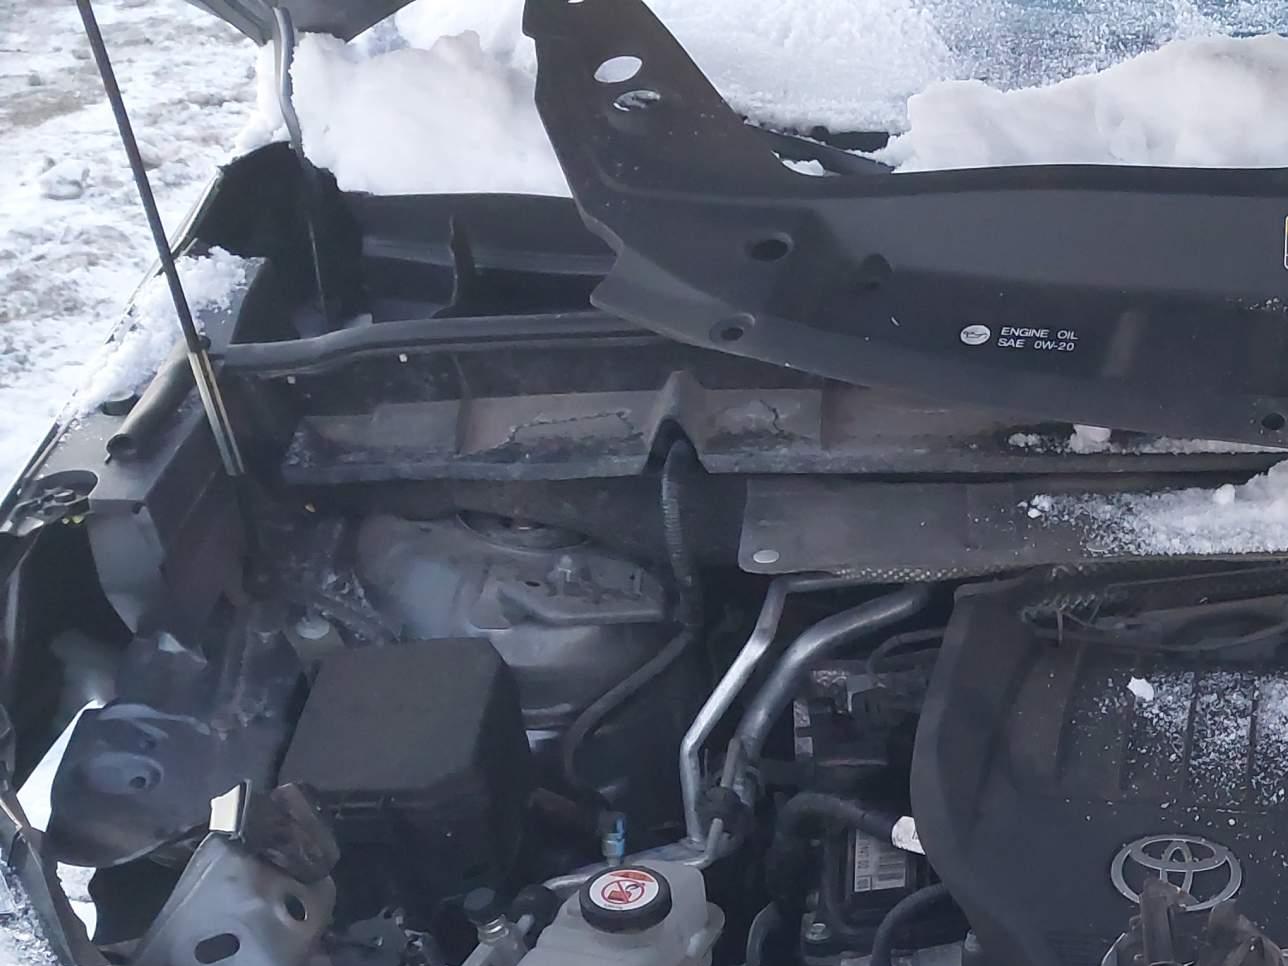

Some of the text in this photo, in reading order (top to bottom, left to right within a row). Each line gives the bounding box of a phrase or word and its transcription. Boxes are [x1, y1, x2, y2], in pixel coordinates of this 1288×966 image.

[1001, 327, 1078, 340] ENGINE OIL
[998, 338, 1075, 351] SAE 0W-20
